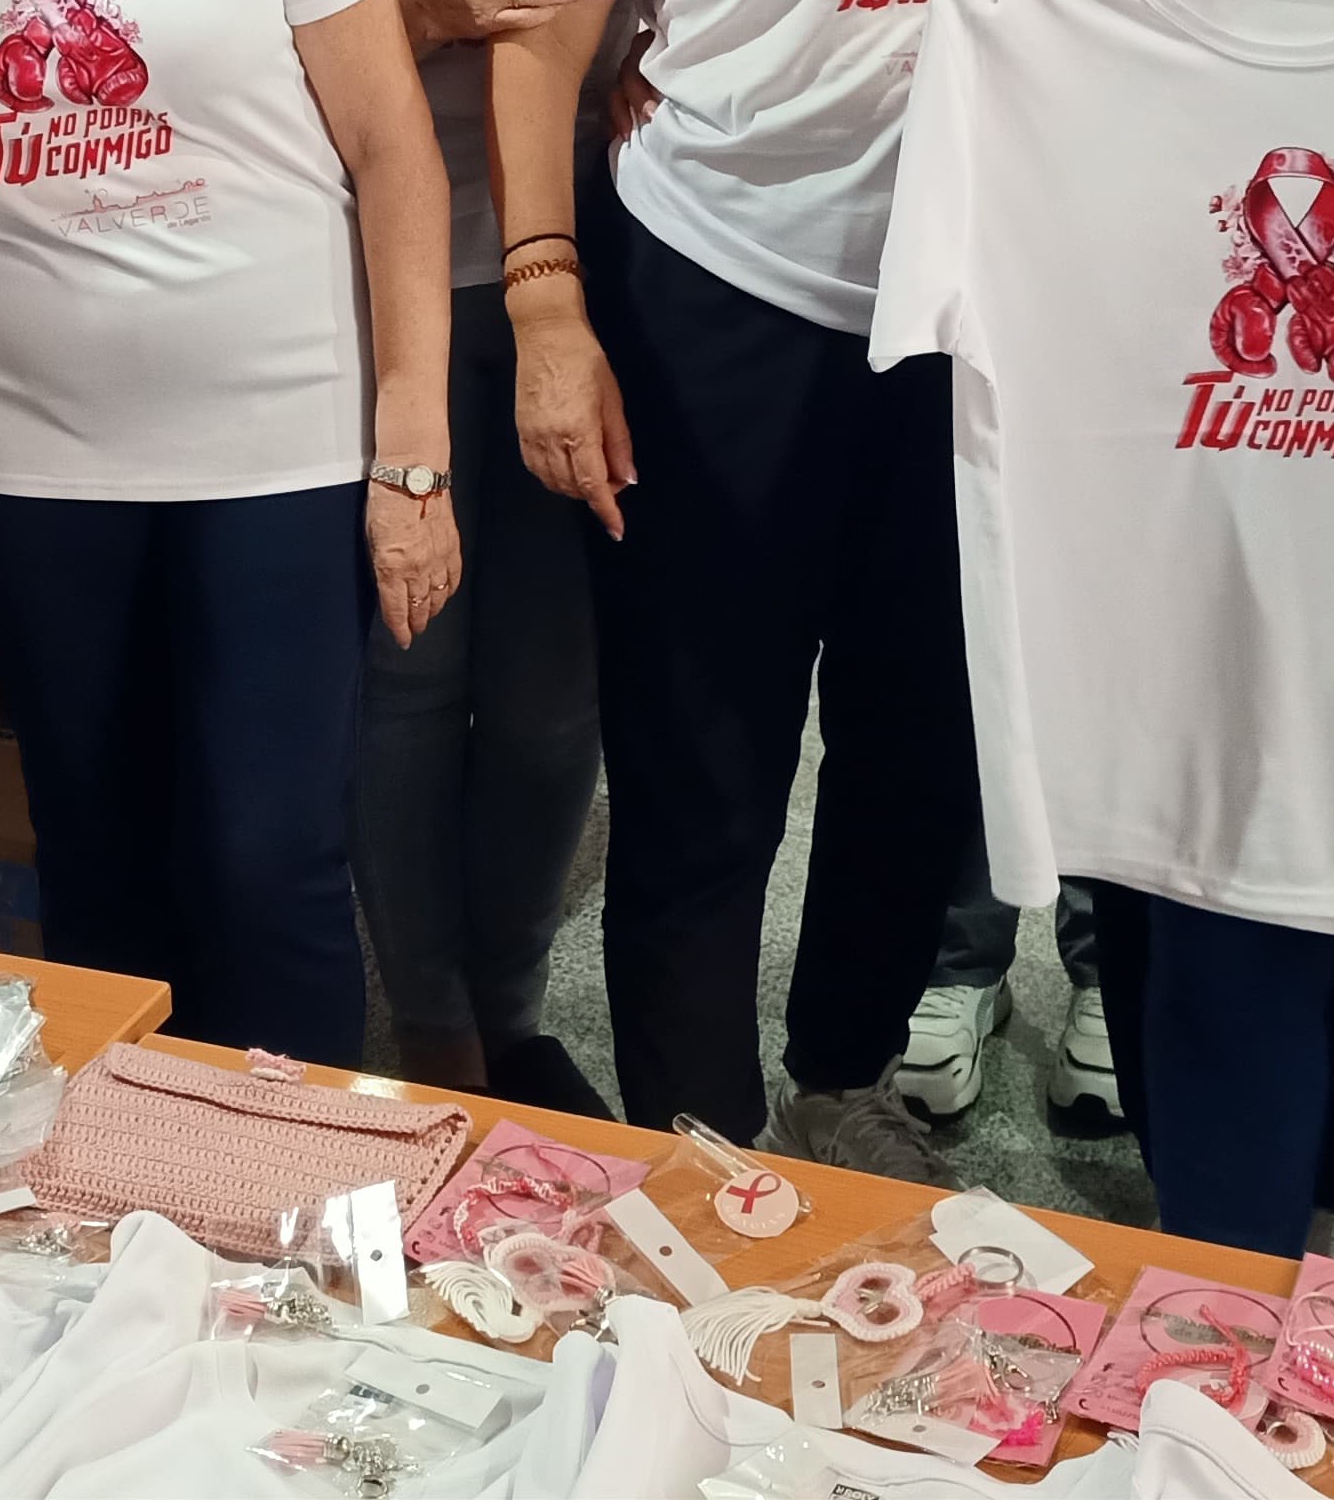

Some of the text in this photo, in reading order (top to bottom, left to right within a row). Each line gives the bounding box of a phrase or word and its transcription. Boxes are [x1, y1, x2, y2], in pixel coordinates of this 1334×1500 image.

[47, 113, 77, 144] NO
[45, 125, 173, 179] CONMIGO
[58, 196, 210, 237] VALVERDE
[1256, 388, 1294, 416] NO
